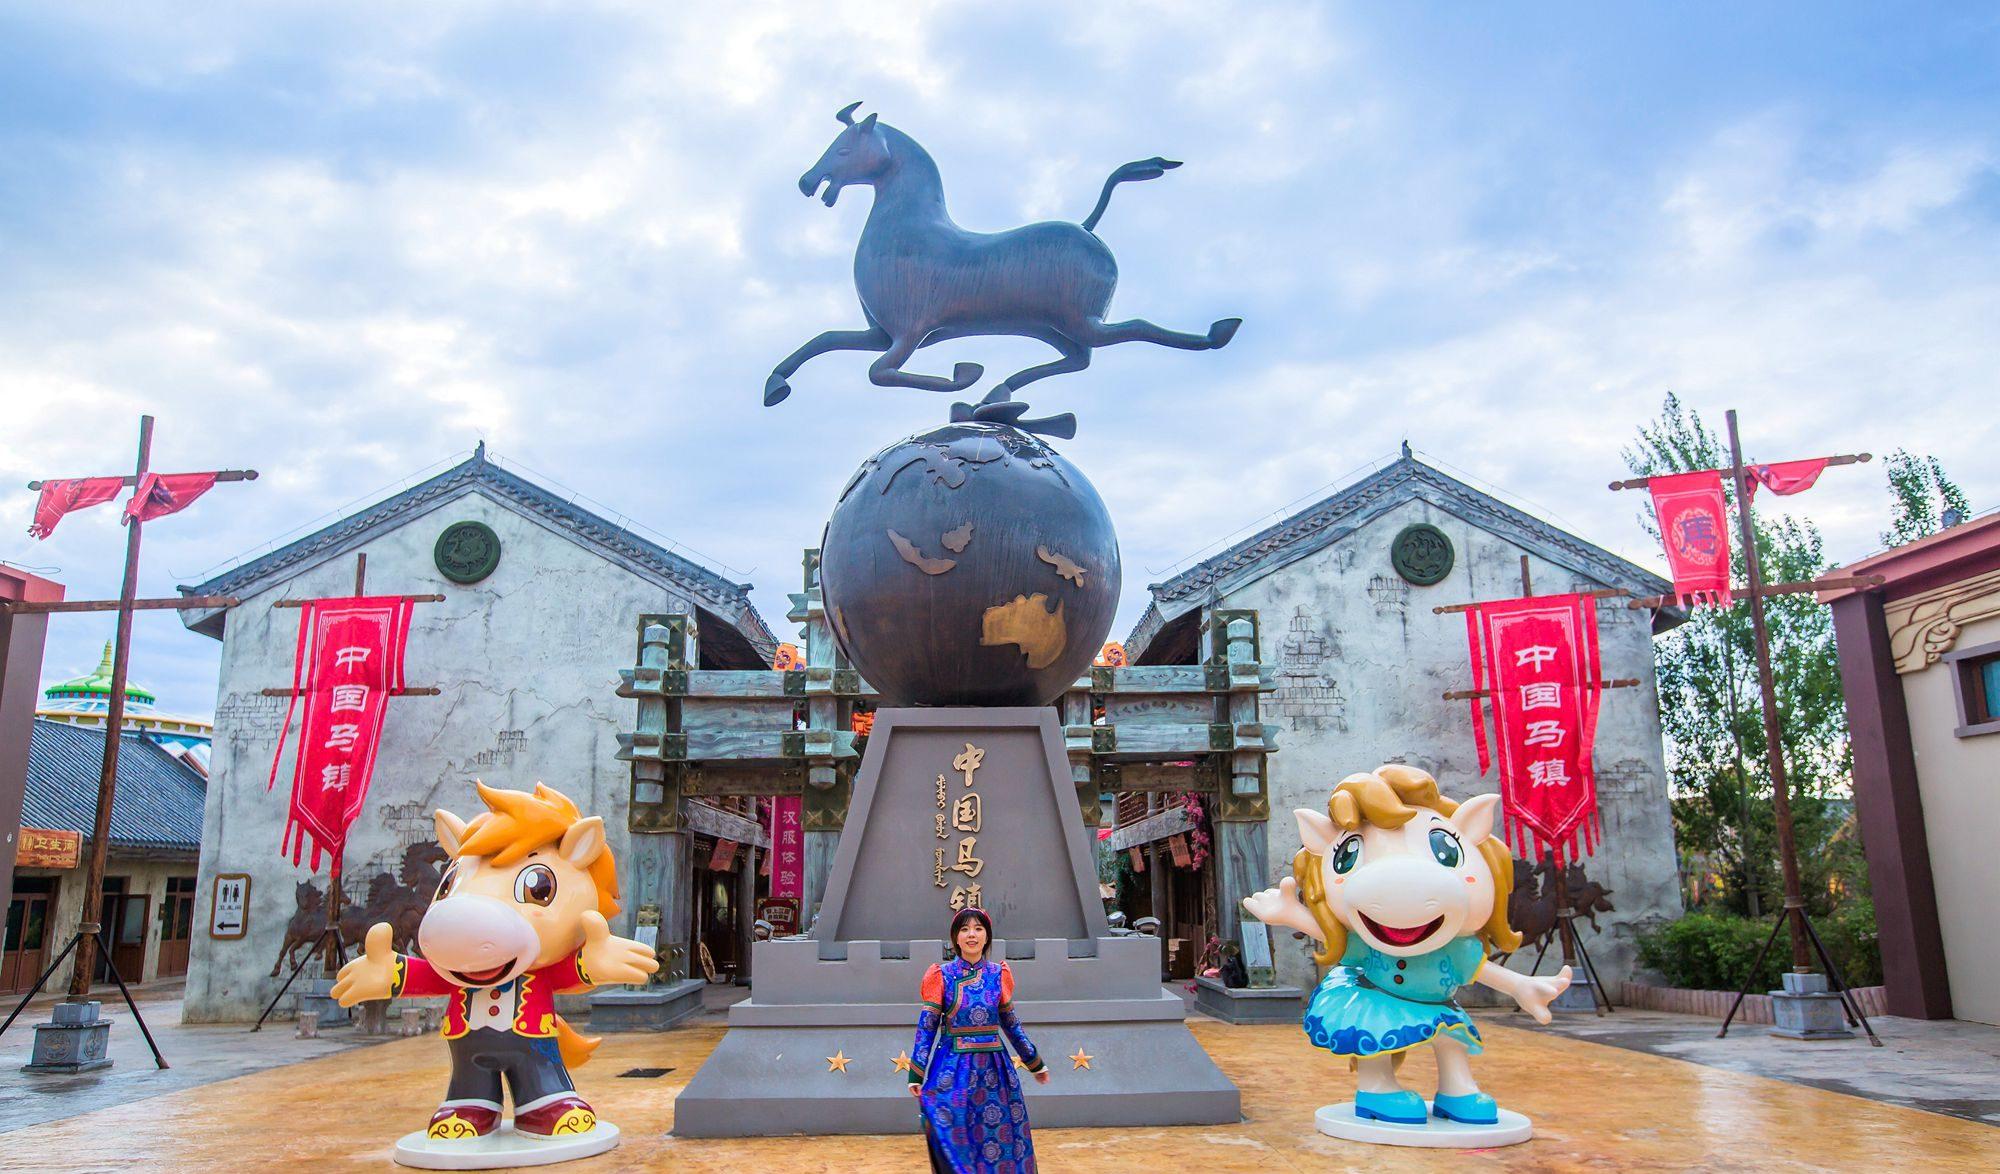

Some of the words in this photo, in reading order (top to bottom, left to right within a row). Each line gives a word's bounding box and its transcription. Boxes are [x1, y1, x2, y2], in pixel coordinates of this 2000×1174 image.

[321, 645, 372, 793] 中国马镇
[1514, 644, 1572, 788] 中国马镇
[950, 742, 986, 912] 中国马镇
